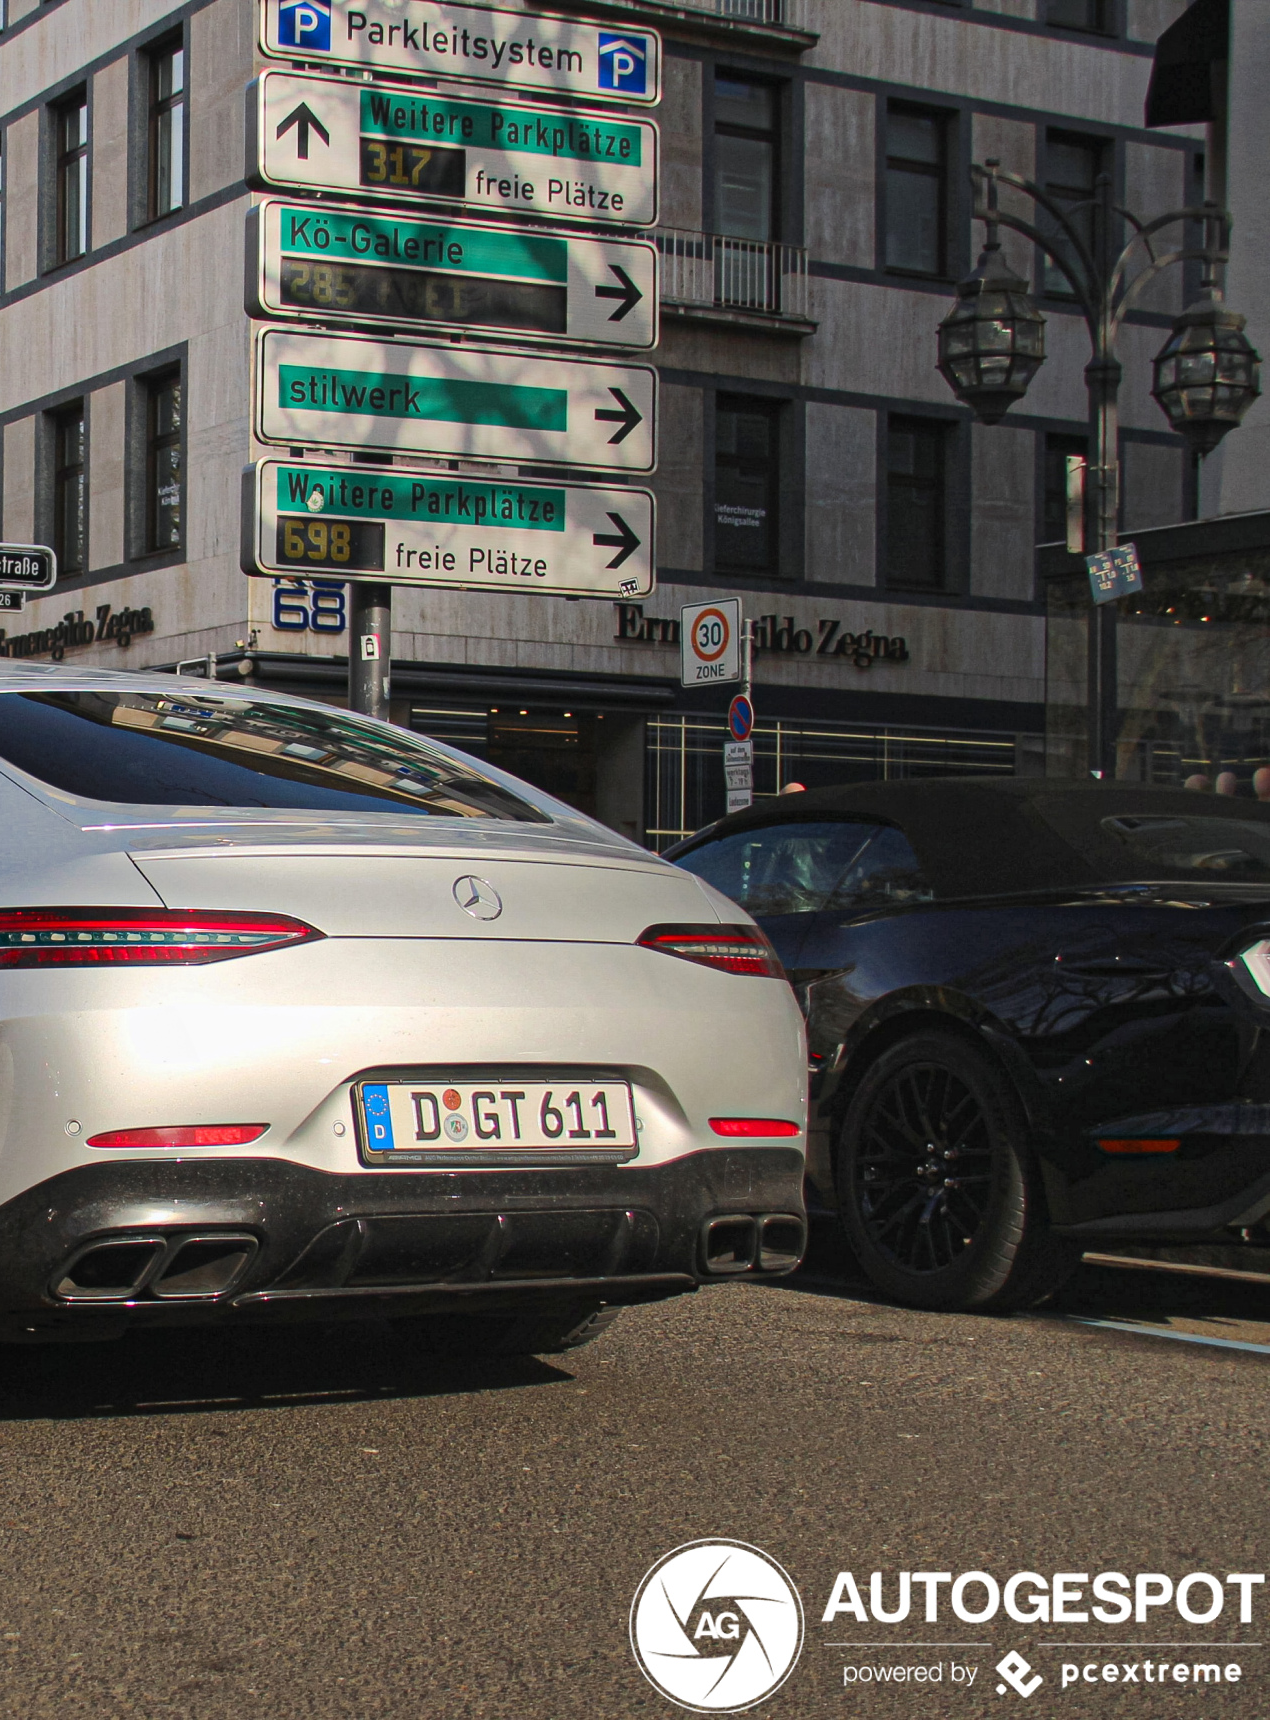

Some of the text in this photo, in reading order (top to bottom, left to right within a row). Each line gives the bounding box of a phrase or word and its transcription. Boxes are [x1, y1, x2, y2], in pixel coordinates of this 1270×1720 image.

[348, 11, 584, 74] Parkleitsystem
[370, 95, 631, 158] Weitere Parkplätze
[367, 143, 432, 185] 317
[476, 170, 625, 212] freie Plätze
[291, 216, 464, 265] Kö-Galerie
[290, 375, 421, 414] stilwerk
[412, 482, 556, 526] Parkplätze
[284, 521, 351, 561] 698
[396, 543, 548, 578] freie Plätze
[95, 604, 154, 647] Zegna
[273, 588, 346, 633] 68
[613, 603, 908, 667] Ermildo Zegna
[699, 622, 721, 647] 30
[696, 664, 725, 679] ZONE
[374, 1125, 386, 1139] D
[411, 1091, 616, 1141] D GT 611
